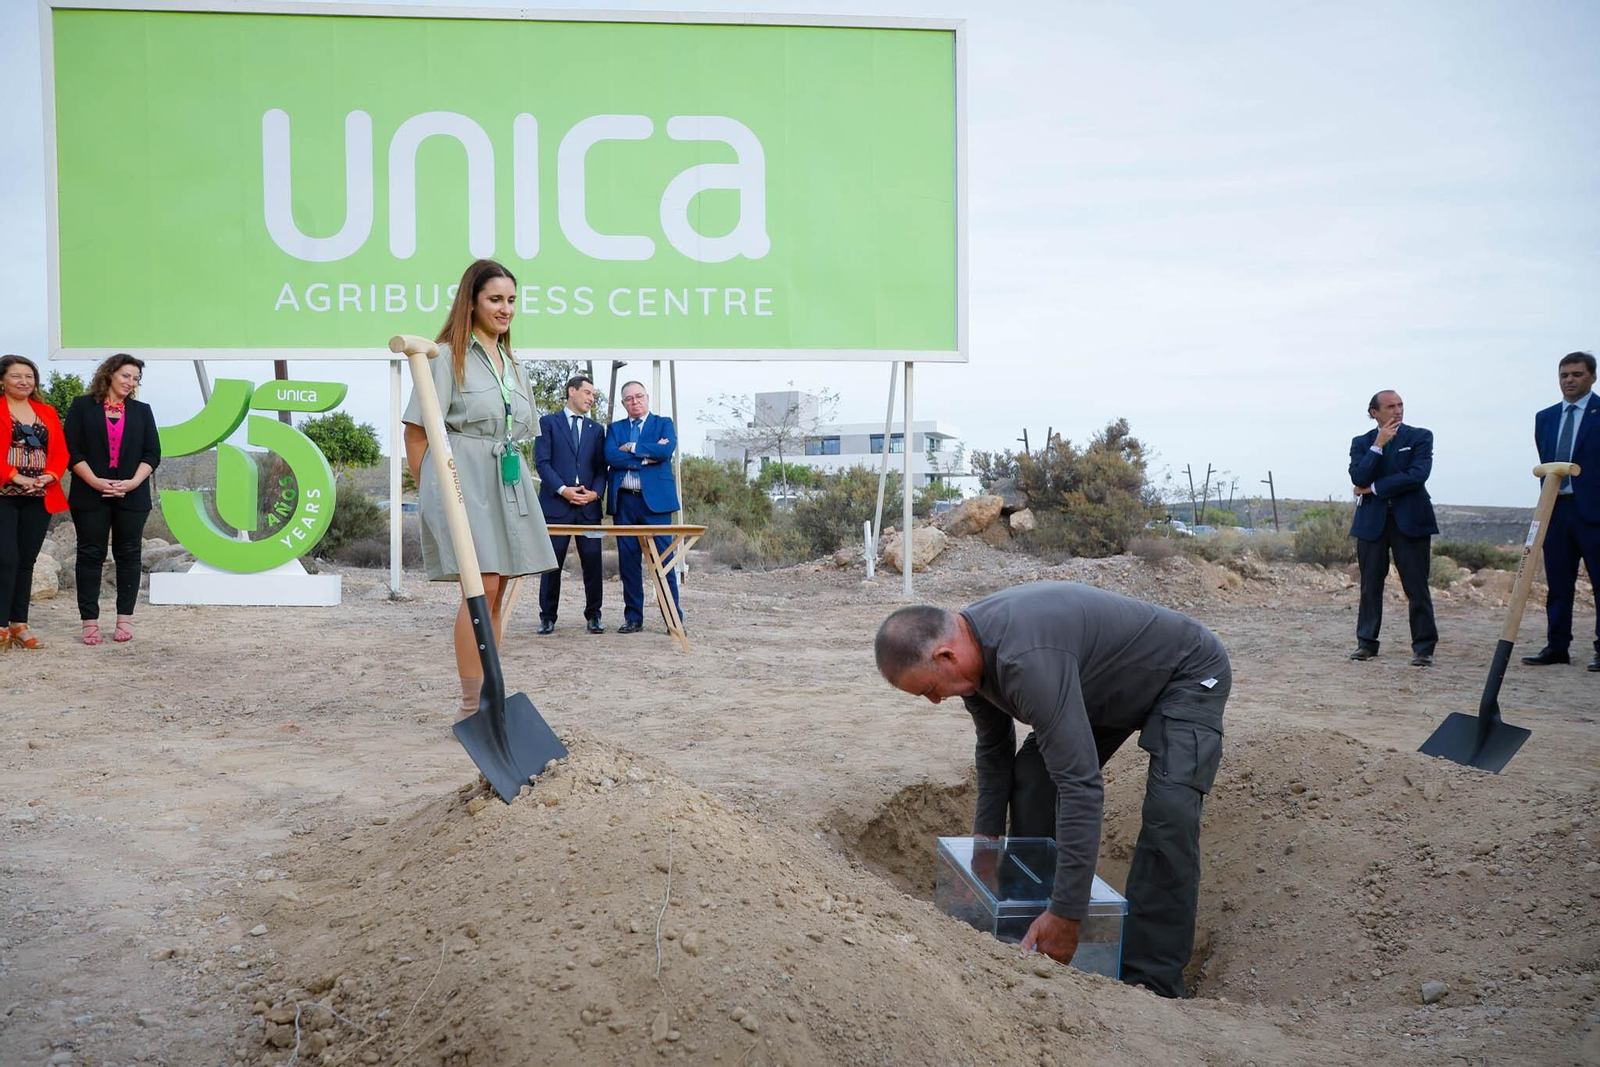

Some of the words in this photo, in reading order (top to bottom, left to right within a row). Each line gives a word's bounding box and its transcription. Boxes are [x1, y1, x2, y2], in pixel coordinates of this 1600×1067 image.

[275, 282, 594, 315] AGRIBUSESS
[608, 287, 773, 316] CENTRE
[267, 475, 297, 527] AÑOS
[280, 488, 320, 549] YEARS
